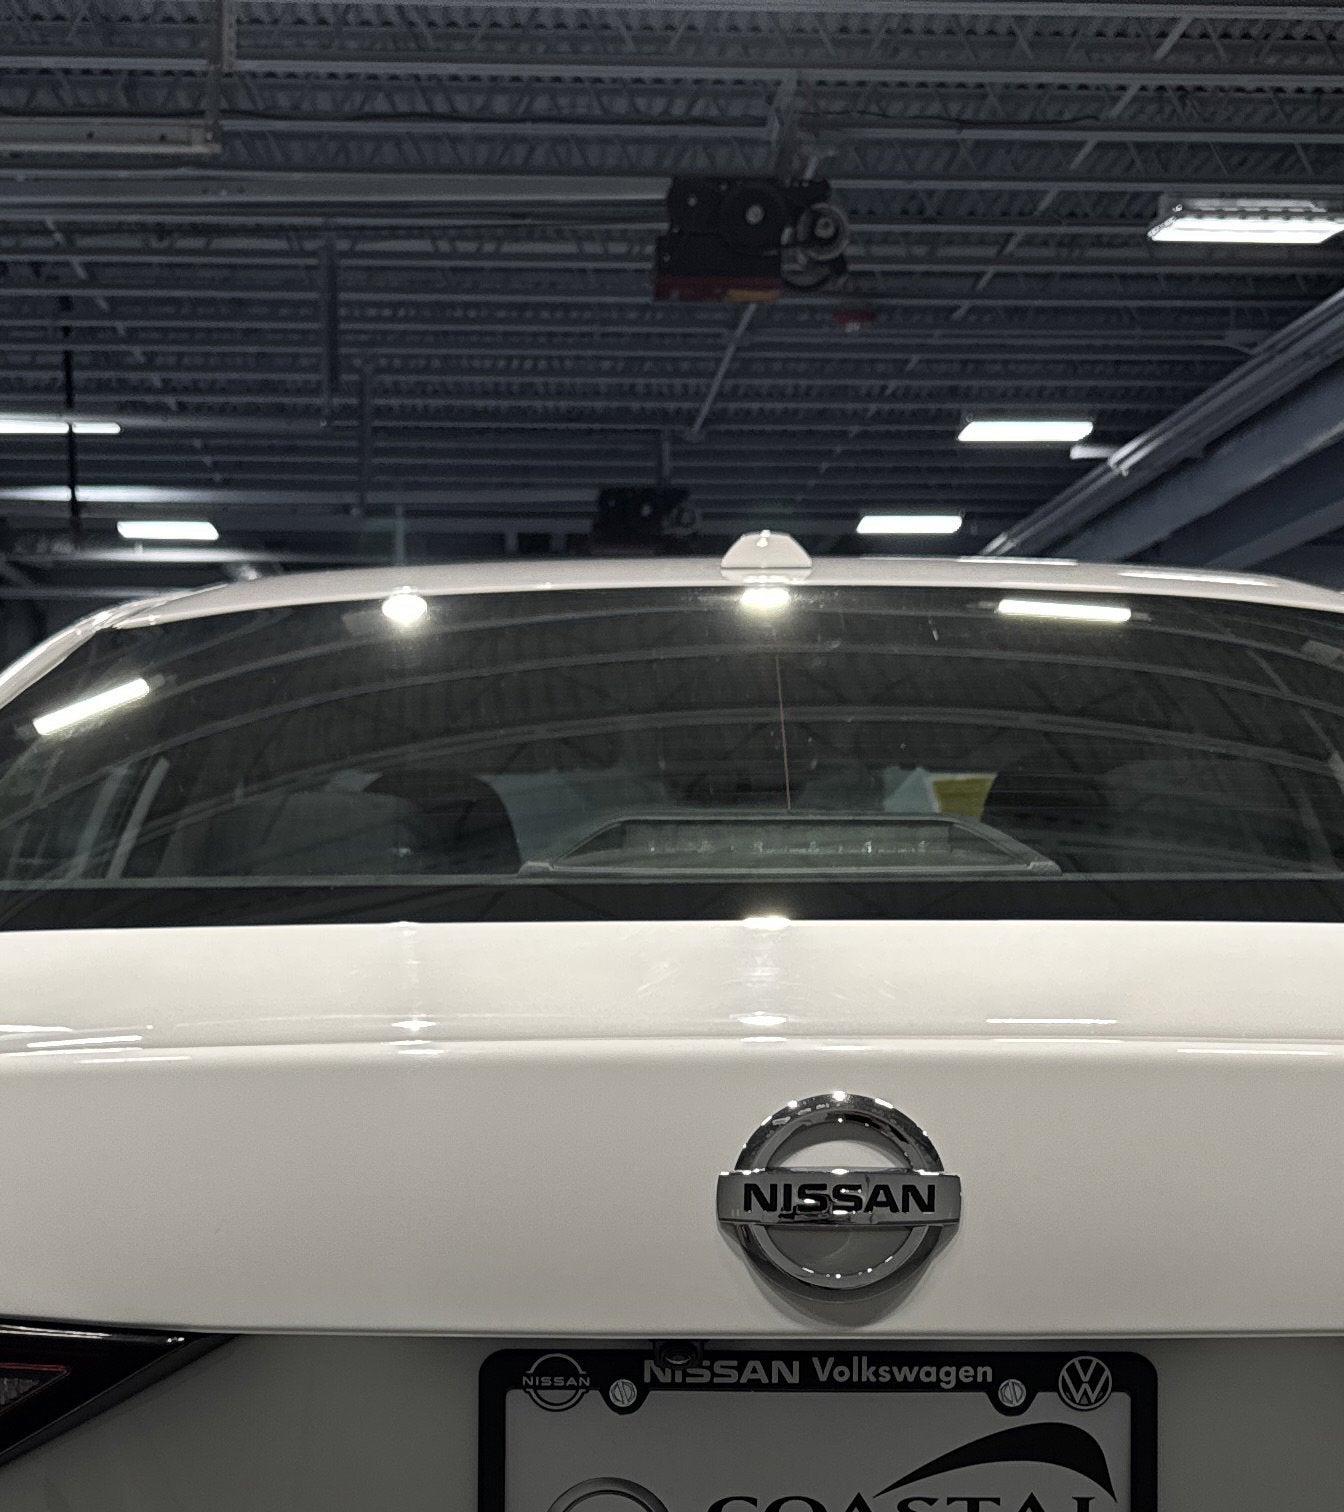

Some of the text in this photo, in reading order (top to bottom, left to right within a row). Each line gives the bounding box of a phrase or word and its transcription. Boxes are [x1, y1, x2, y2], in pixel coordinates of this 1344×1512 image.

[742, 1182, 937, 1214] NISSAN
[522, 1375, 591, 1387] NISSAN
[643, 1356, 994, 1388] NISSAN Volkswagen
